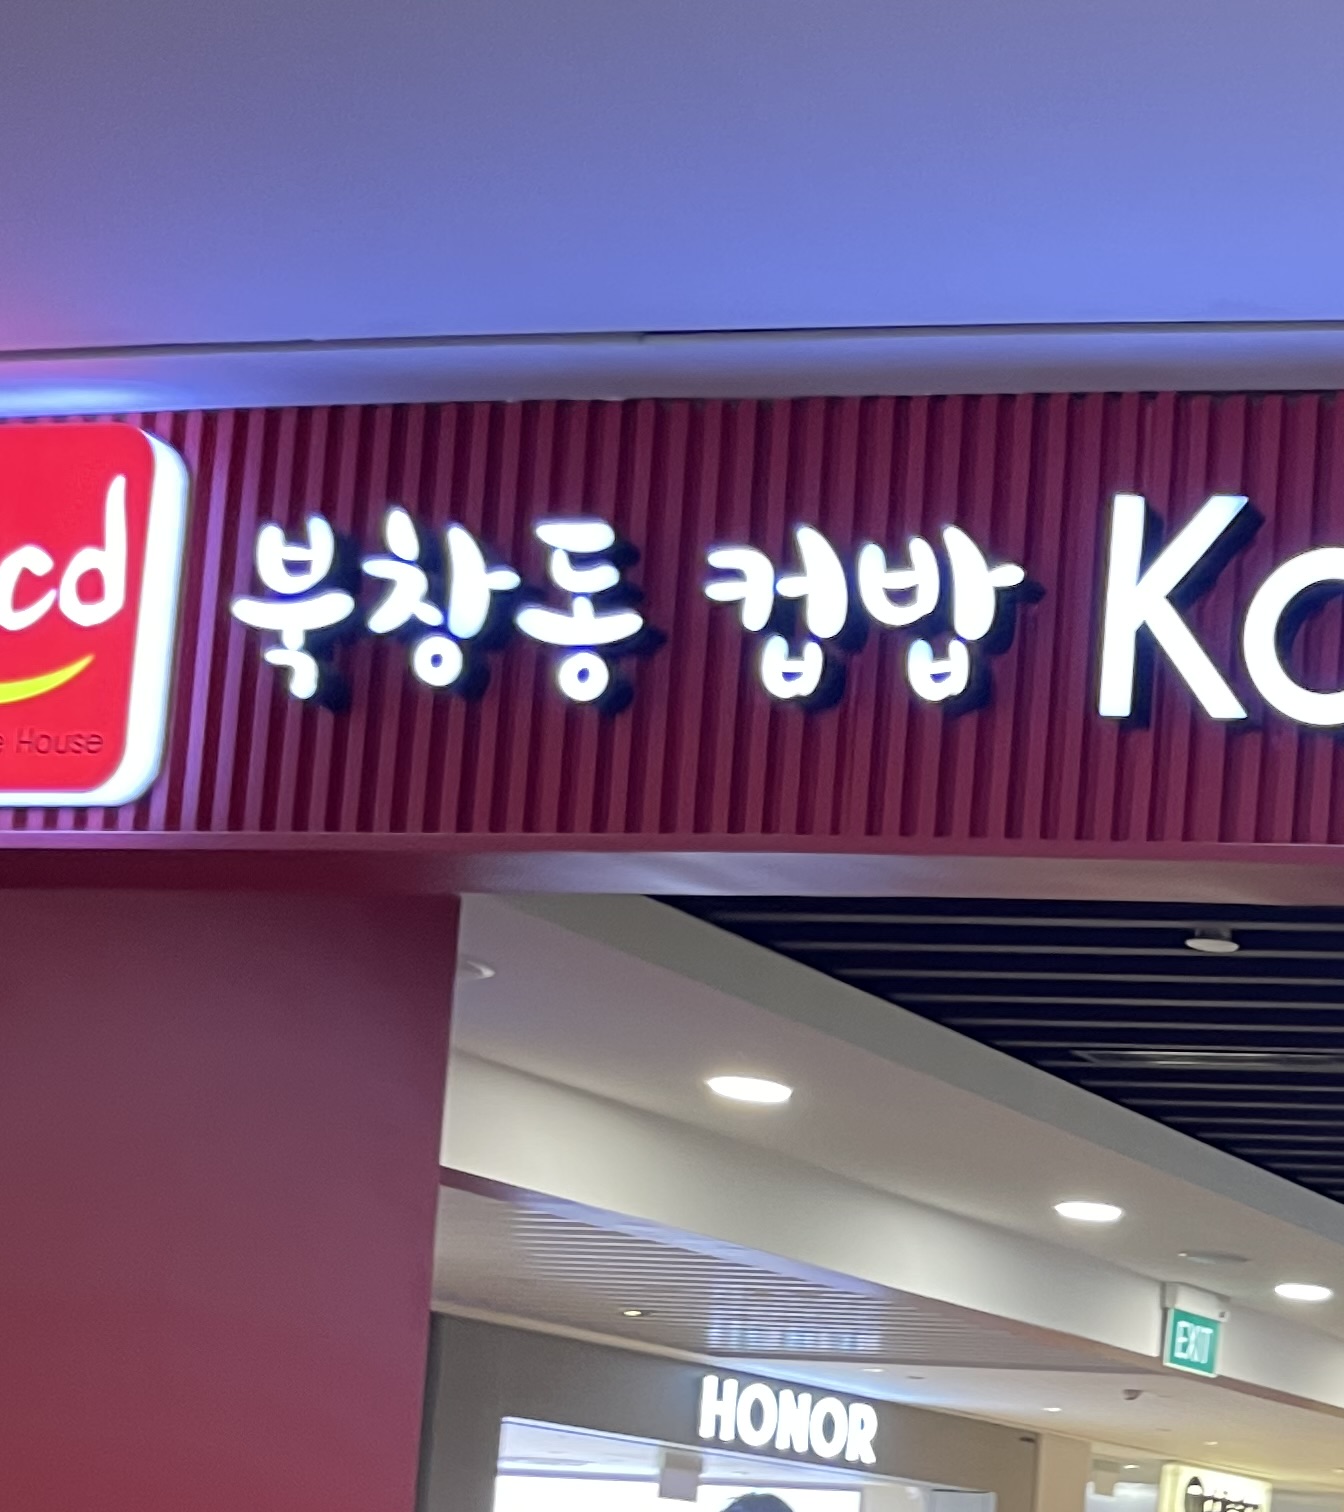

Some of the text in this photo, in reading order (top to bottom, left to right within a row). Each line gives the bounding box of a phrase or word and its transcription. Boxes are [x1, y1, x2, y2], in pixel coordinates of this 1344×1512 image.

[231, 507, 1026, 702] 북창동 컵밥
[15, 727, 104, 755] House
[1174, 1320, 1214, 1364] EXIT
[699, 1375, 878, 1464] HONOR
